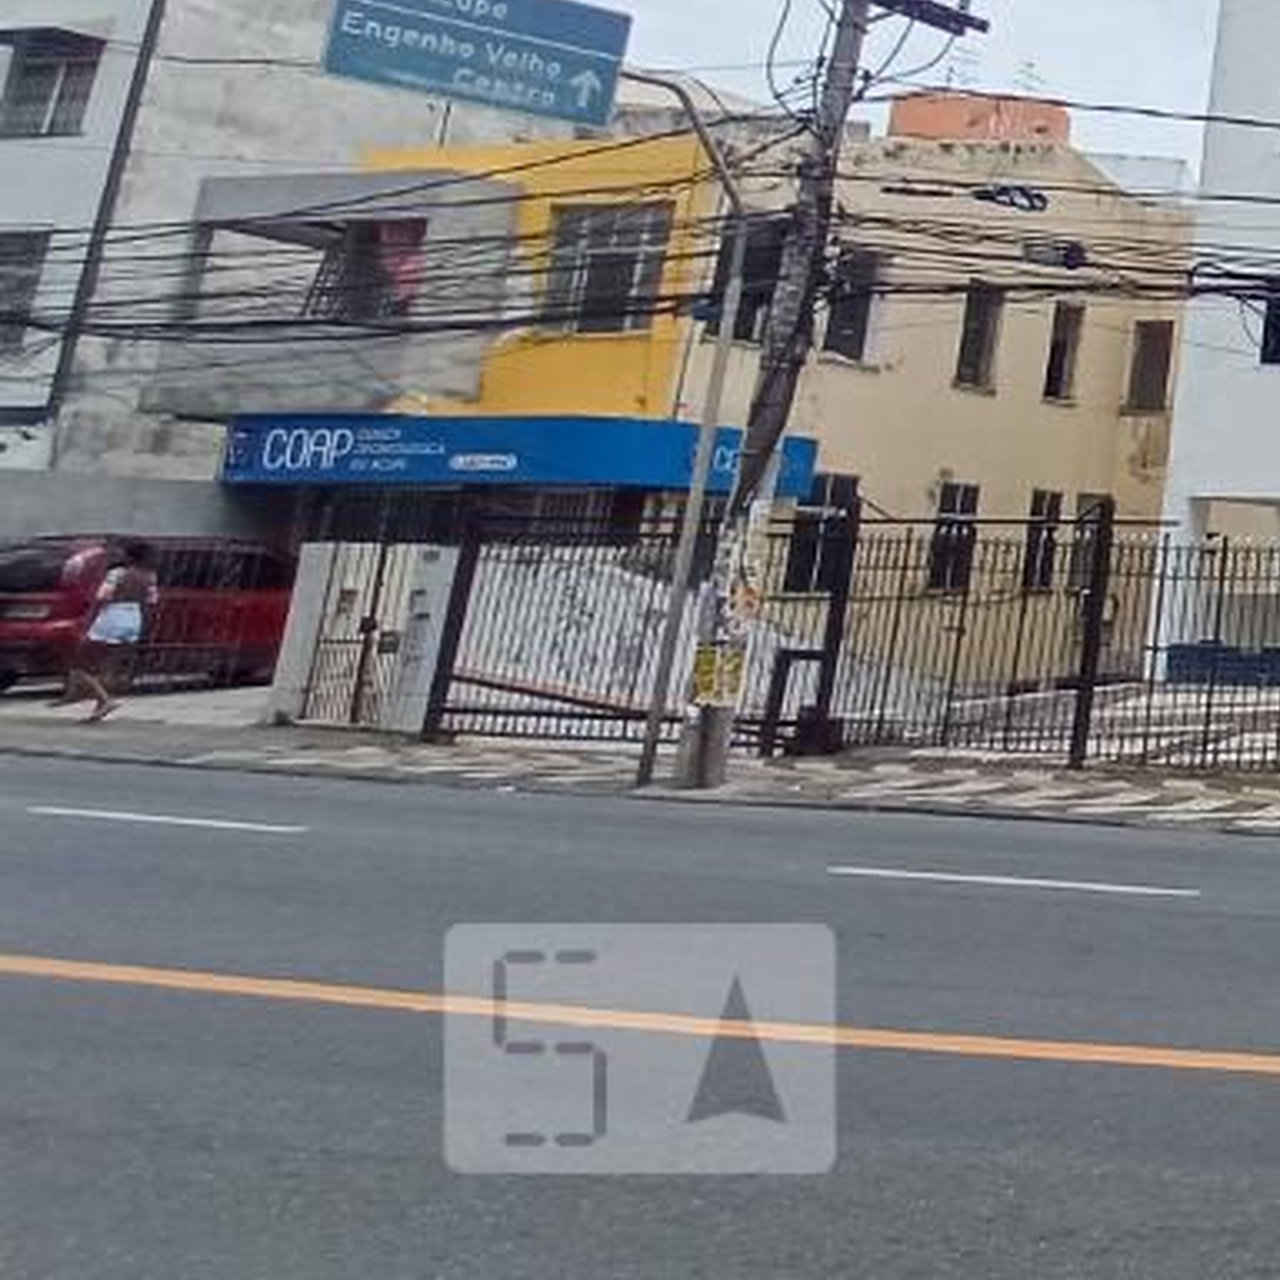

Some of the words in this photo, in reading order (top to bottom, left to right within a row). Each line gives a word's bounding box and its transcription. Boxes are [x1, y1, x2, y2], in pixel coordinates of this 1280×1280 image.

[341, 11, 475, 58] Engenho
[485, 42, 561, 80] Velho
[452, 67, 555, 106] Centro
[262, 428, 353, 470] COAP
